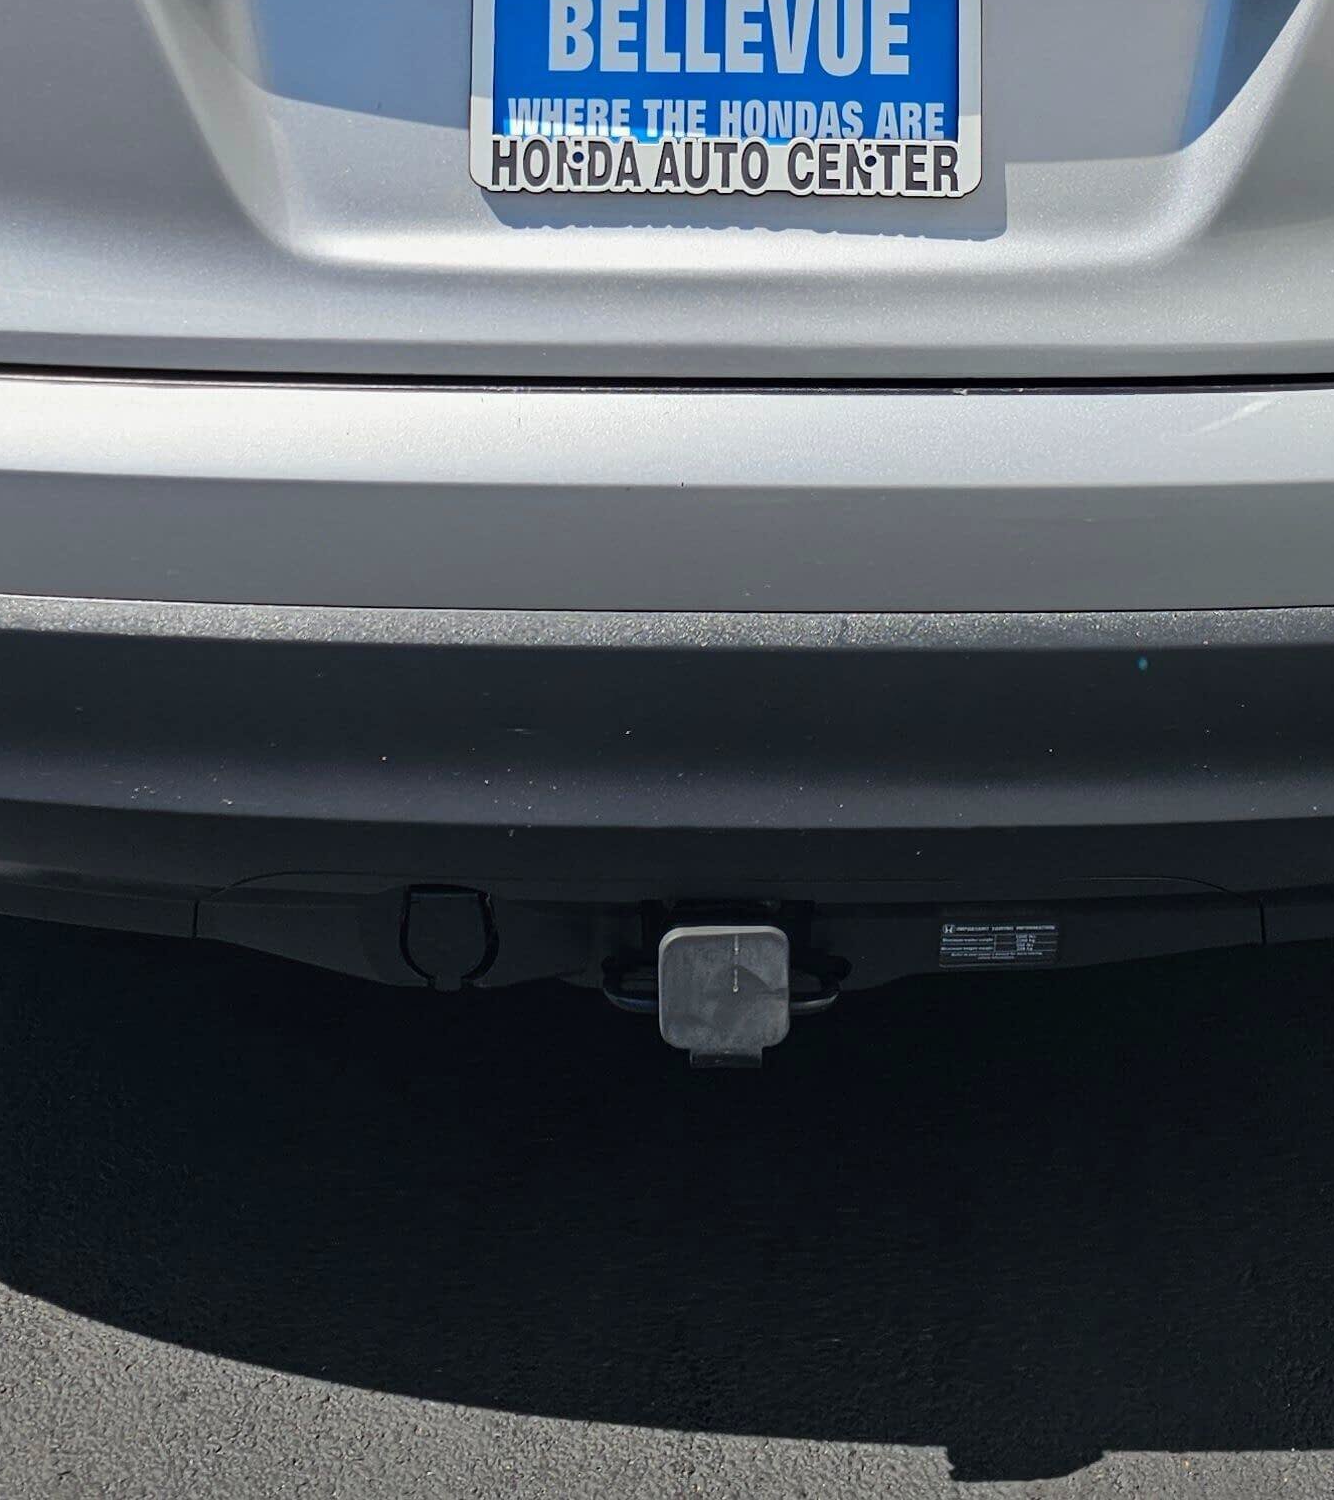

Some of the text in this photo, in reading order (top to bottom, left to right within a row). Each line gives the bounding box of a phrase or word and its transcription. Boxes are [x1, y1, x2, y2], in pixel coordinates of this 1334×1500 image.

[507, 97, 945, 140] WHERE THE HONDAS ARE
[491, 140, 959, 192] HONDA AUTO CENTER
